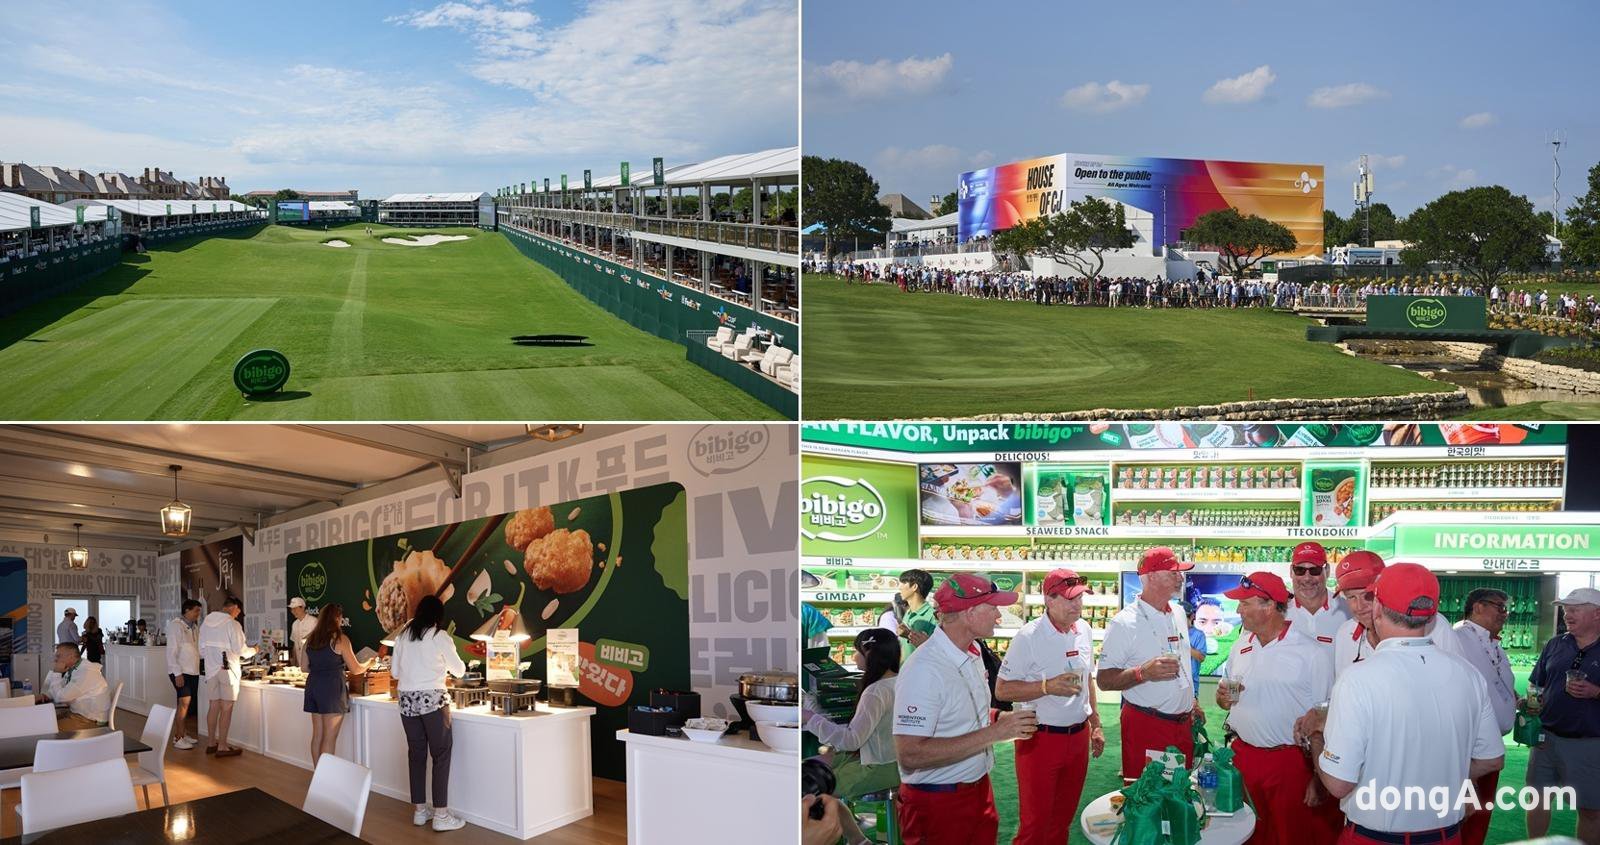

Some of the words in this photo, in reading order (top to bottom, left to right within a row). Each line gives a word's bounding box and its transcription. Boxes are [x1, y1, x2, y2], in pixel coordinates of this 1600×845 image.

[1027, 164, 1055, 190] HOUSE
[1075, 168, 1098, 180] Open
[1099, 170, 1108, 179] to
[1109, 170, 1124, 180] the
[1125, 171, 1151, 181] public
[1040, 192, 1052, 215] OF
[1052, 190, 1064, 213] CJ
[1410, 306, 1444, 319] bibigo
[243, 365, 282, 379] bibigo
[943, 425, 1009, 445] Unpack
[695, 430, 763, 457] bibigo
[706, 451, 735, 464] 비비고
[995, 452, 1050, 461] DELICIOUS!
[503, 464, 549, 513] IT
[811, 514, 847, 527] 비비고
[1026, 527, 1072, 536] SEAWEED
[1075, 526, 1109, 536] SNACK
[1287, 528, 1358, 537] TTEOKBOKKI
[1434, 532, 1590, 549] INFORMATION
[826, 557, 853, 566] 비비고
[1483, 558, 1541, 570] 안내데스크
[27, 573, 93, 590] PROVIDING
[97, 575, 157, 600] SOLUTIONS
[301, 573, 325, 589] bibigo
[688, 568, 799, 623] LICI
[815, 592, 866, 601] GIMBAP
[29, 603, 42, 654] CONNEC
[600, 644, 645, 667] 비비고
